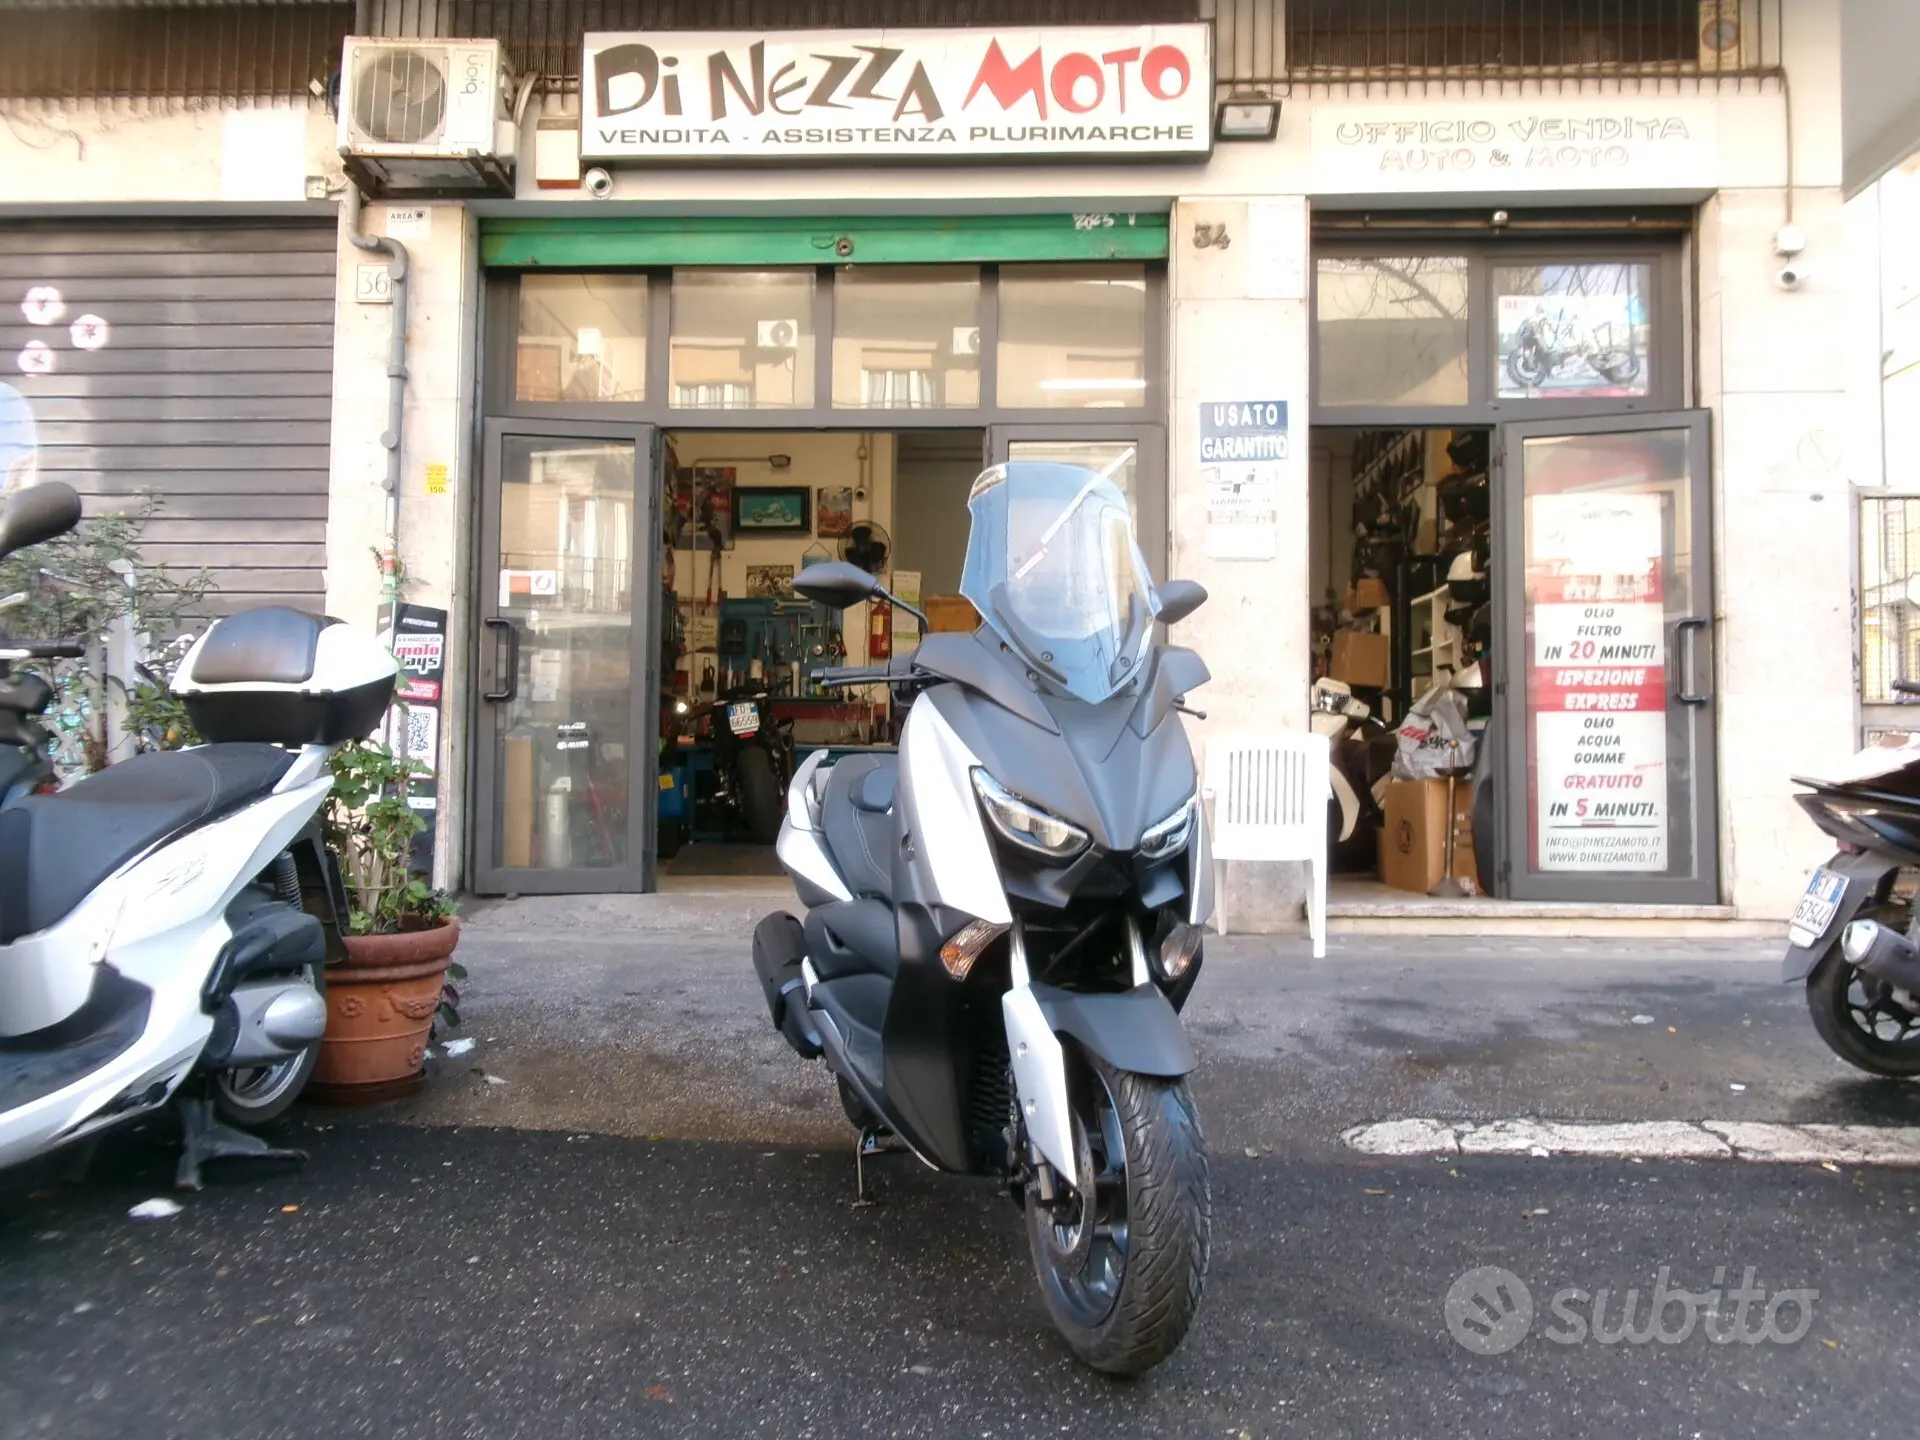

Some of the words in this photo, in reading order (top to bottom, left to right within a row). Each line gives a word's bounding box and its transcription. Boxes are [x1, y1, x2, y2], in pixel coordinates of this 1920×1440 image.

[961, 36, 1191, 121] MOTO
[599, 128, 730, 144] VENDITA
[761, 126, 957, 144] ASSISTENZA
[969, 124, 1194, 142] PLURIMARCHE
[1336, 119, 1496, 145] UFFICIO
[1507, 116, 1690, 142] VENDITA
[1379, 148, 1476, 170] AUTO
[1488, 148, 1511, 166] &
[1525, 145, 1630, 168] MOTO
[1192, 222, 1231, 250] 34
[360, 271, 388, 295] 36
[1213, 403, 1278, 427] USATO
[1201, 434, 1289, 460] GARANTITO
[1584, 607, 1614, 619] OLIO
[1577, 625, 1622, 637] FILTRO
[395, 643, 439, 656] moto
[1545, 645, 1562, 660] IN
[1569, 641, 1595, 660] 20
[1599, 644, 1656, 661] MINUTI
[401, 656, 438, 671] ays
[1556, 669, 1647, 687] ISPEZIONE
[1564, 692, 1639, 710] EXPRESS
[1584, 718, 1614, 729] OLIO
[1577, 735, 1621, 748] ACQUA
[1574, 752, 1625, 765] GOMME
[1564, 774, 1644, 790] GRATUITO
[1549, 802, 1568, 817] IN
[1575, 798, 1589, 817] 5
[1546, 836, 1661, 848] INFO@DINEZZAMOTO.IT
[1548, 852, 1658, 863] WWW.DINEZZAMOTO.IT
